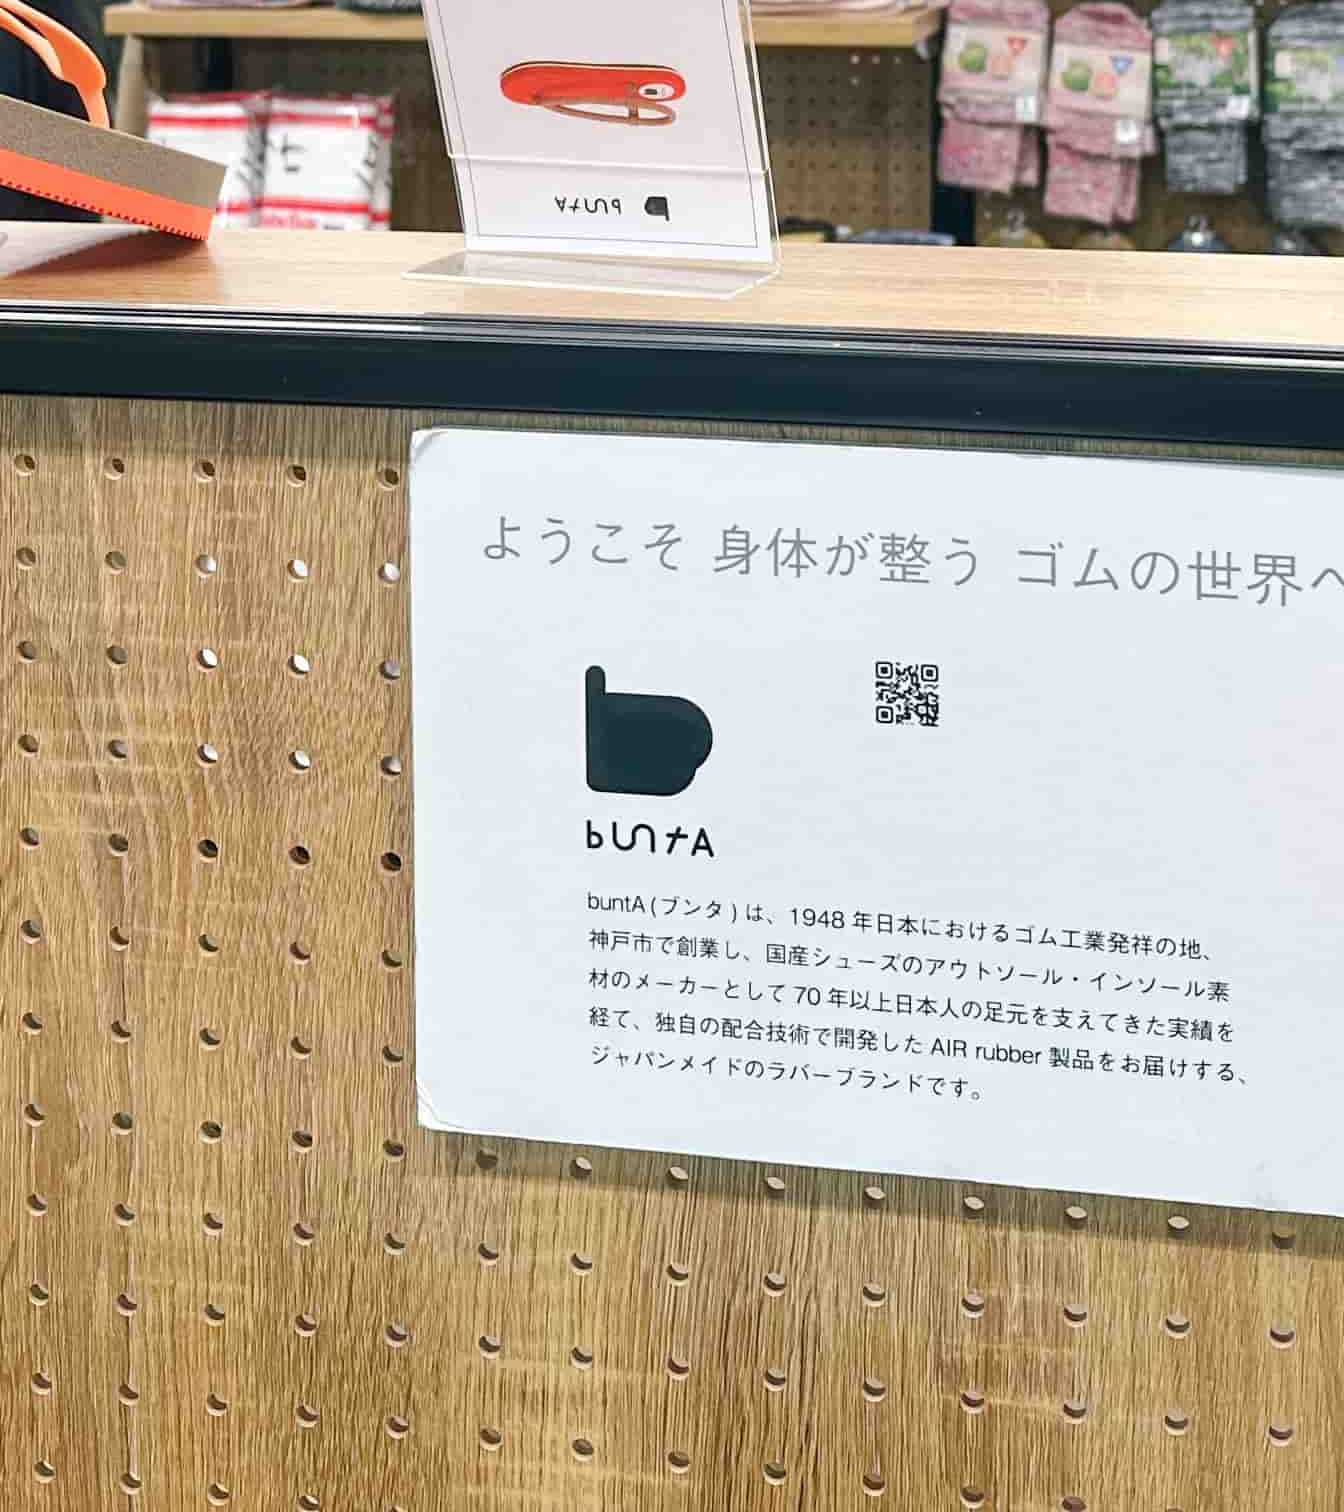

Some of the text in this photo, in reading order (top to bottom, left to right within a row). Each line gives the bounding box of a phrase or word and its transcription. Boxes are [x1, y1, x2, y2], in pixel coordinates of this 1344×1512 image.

[482, 514, 684, 572] ようこそ
[712, 524, 981, 587] 身体が整う
